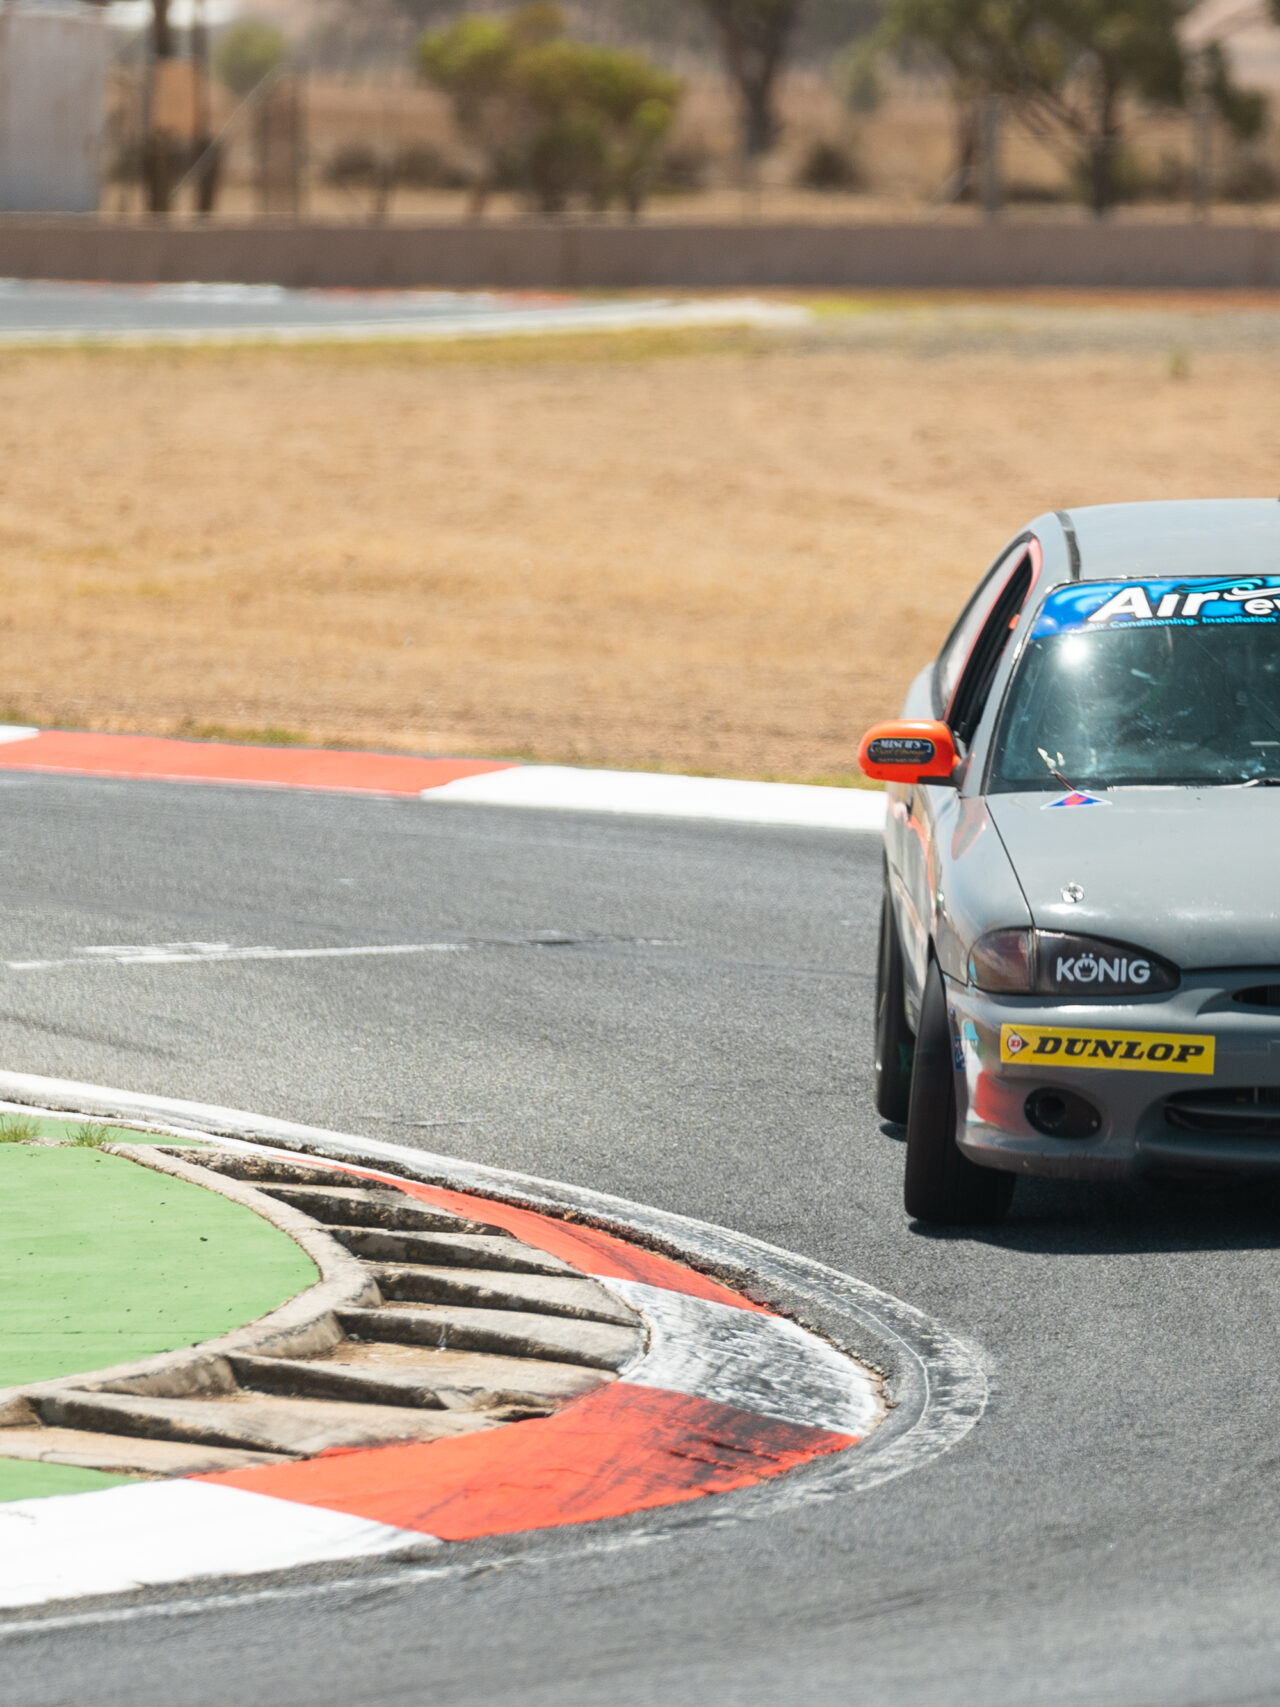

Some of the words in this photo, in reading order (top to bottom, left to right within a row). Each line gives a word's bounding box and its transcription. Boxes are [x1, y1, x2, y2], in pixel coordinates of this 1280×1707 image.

[1088, 586, 1220, 622] Air
[1202, 615, 1276, 624] Installation
[1056, 953, 1151, 984] KÖNIG
[1033, 1036, 1205, 1063] DUNLOP
